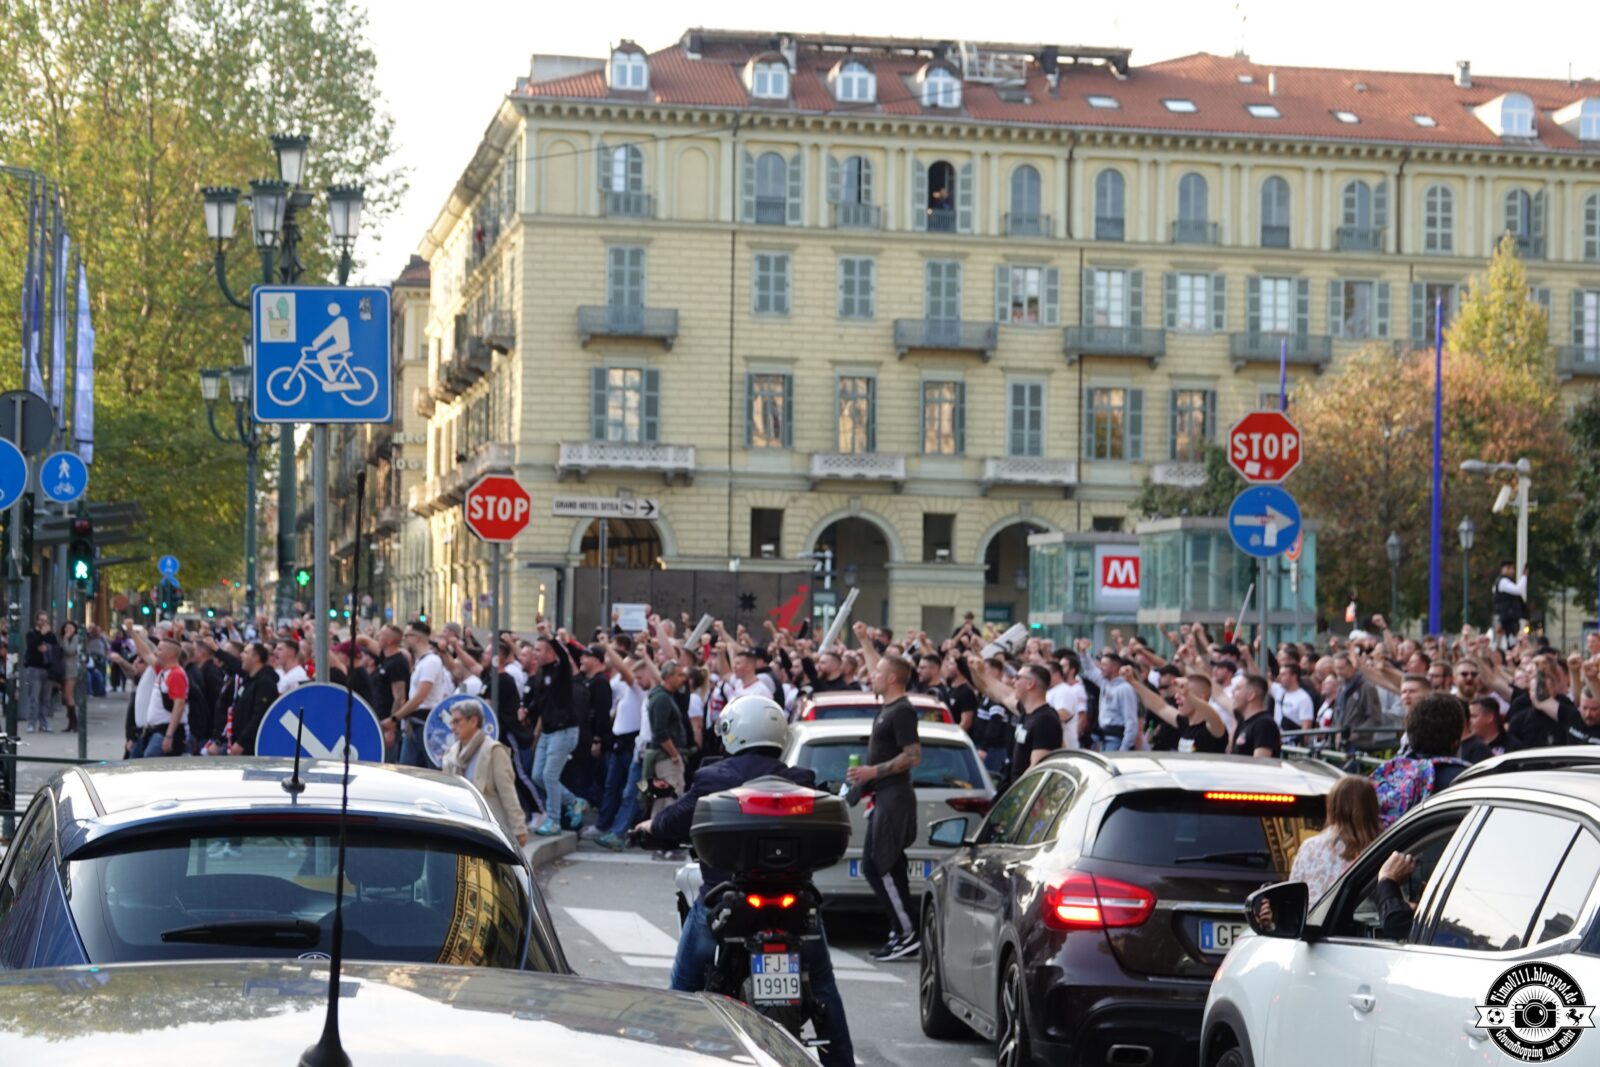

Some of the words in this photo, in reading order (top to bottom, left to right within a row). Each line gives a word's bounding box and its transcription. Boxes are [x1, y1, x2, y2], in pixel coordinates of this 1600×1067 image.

[1233, 432, 1298, 460] STOP
[470, 495, 528, 522] STOP
[555, 501, 577, 510] GRAND
[579, 502, 599, 511] HOTEL
[1106, 559, 1137, 585] M
[764, 955, 781, 972] FJ
[756, 977, 799, 995] 19919
